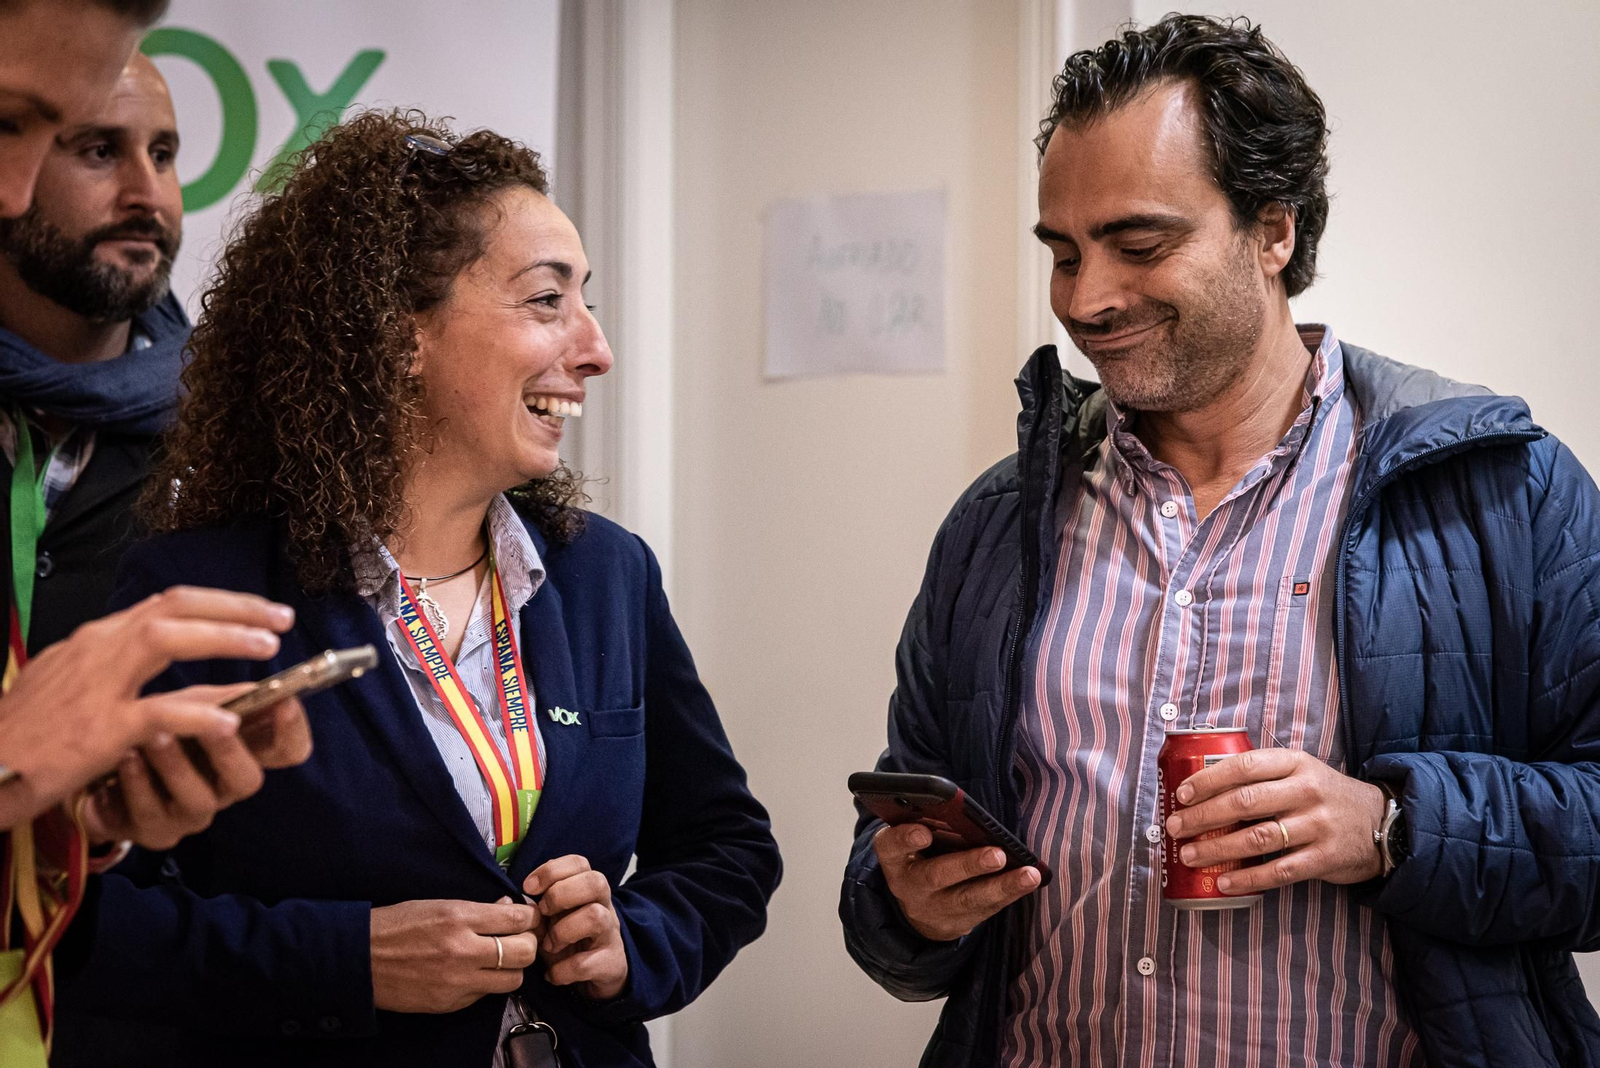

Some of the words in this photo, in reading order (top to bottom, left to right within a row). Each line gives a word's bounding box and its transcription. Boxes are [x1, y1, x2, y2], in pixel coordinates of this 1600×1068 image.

[410, 626, 453, 684] SIEMPRE
[495, 618, 518, 676] ESPAÑA
[502, 676, 529, 733] SIEMPRE
[547, 706, 582, 725] VOX
